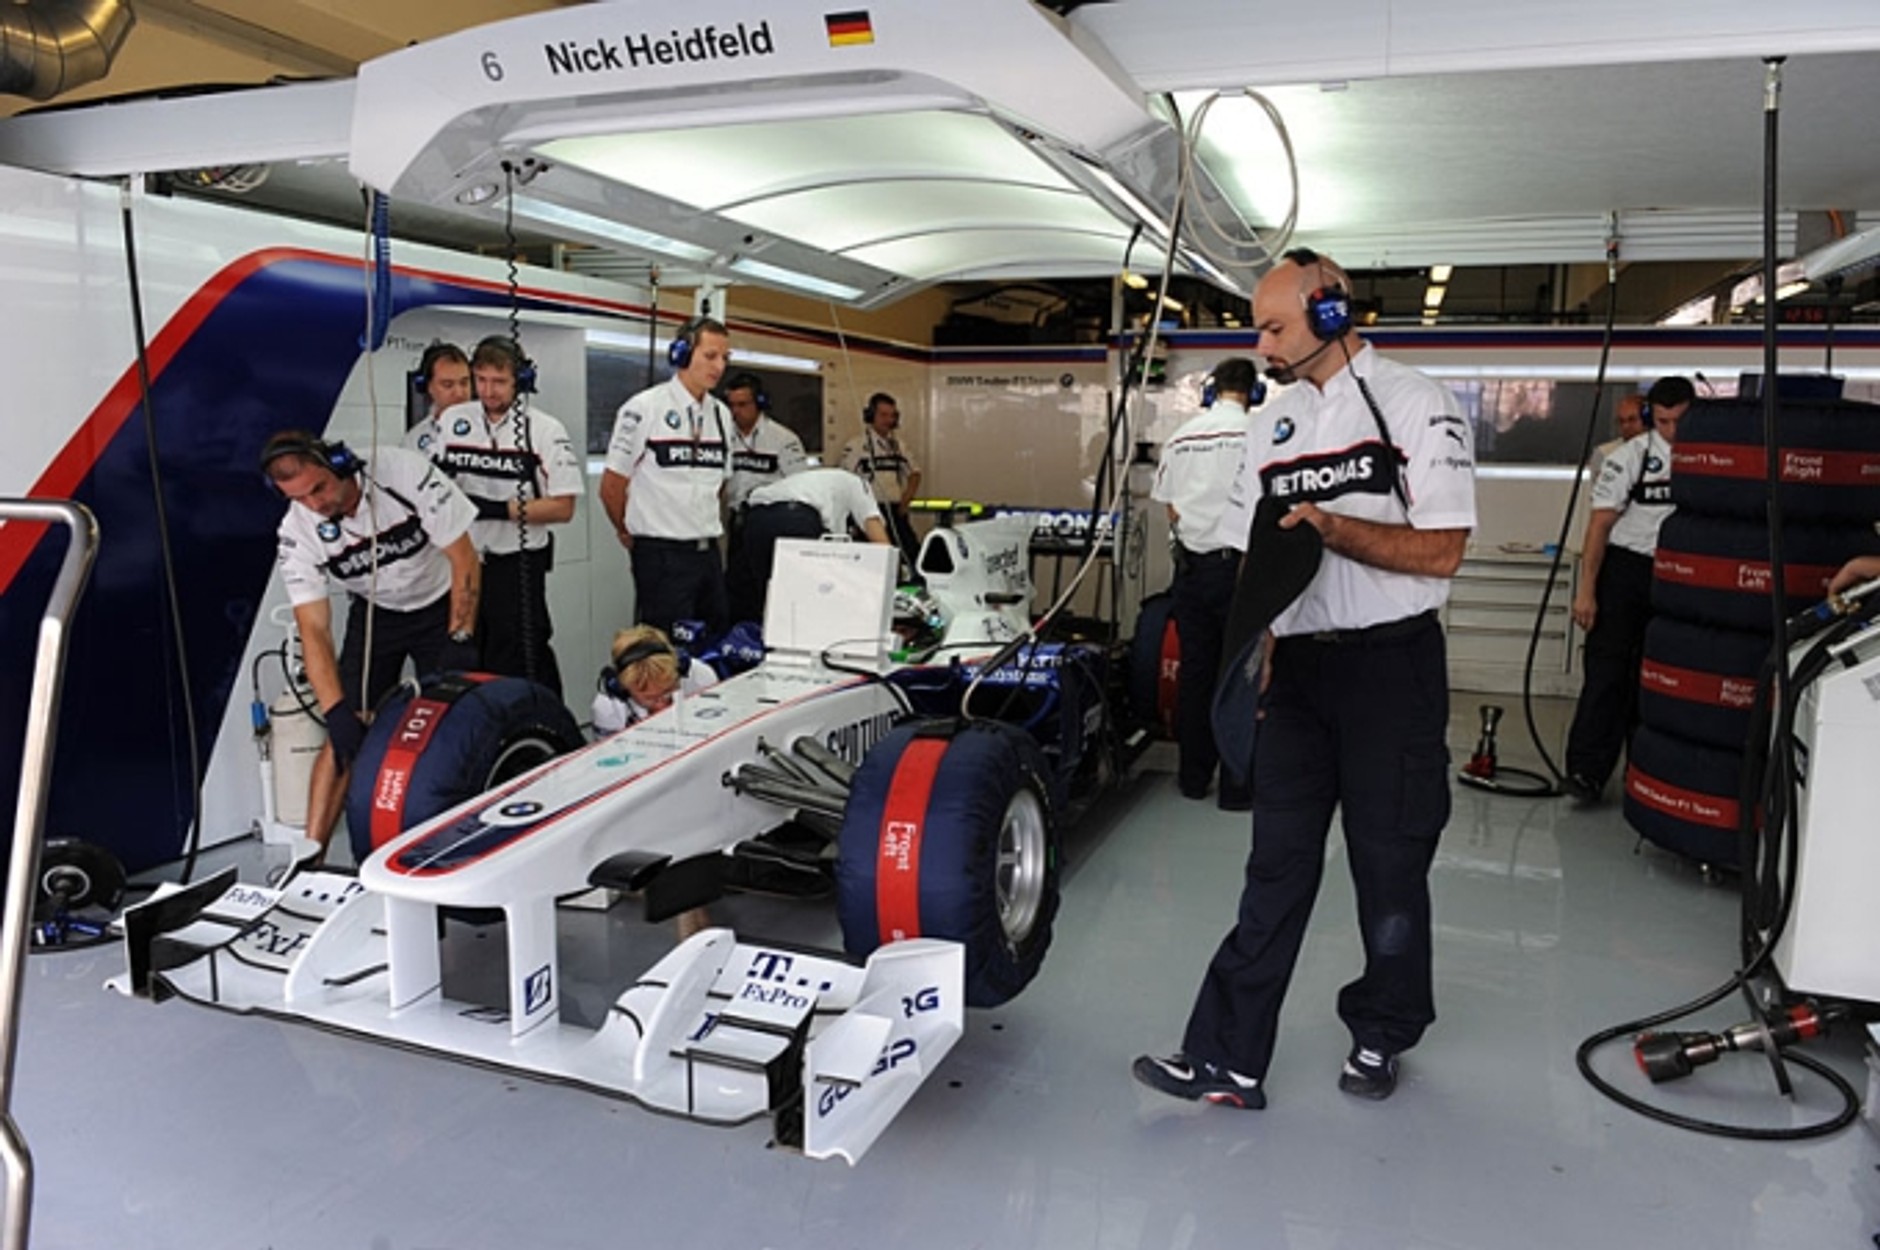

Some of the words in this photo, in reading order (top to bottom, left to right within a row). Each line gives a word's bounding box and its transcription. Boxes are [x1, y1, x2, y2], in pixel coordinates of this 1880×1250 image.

[544, 39, 623, 74] Nick
[625, 21, 774, 67] Heidfeld
[480, 51, 503, 82] 6
[1739, 564, 1771, 579] Fron
[884, 821, 901, 857] Left
[896, 822, 917, 871] Front
[740, 981, 810, 1010] FxPro
